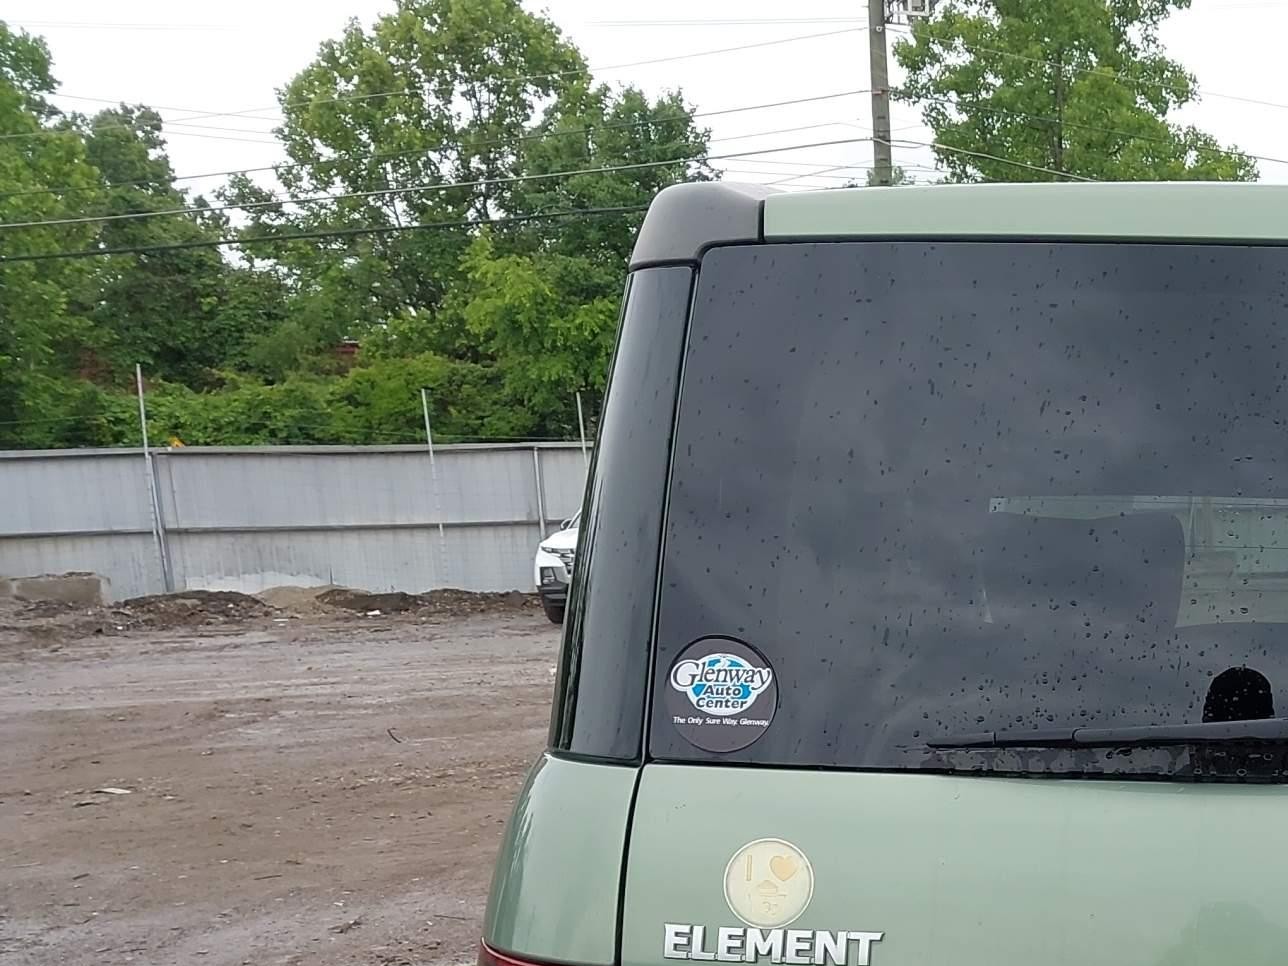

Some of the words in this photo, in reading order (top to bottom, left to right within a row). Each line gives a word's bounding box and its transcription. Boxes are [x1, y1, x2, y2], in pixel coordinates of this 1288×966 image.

[672, 661, 771, 691] Glenway
[702, 685, 742, 696] Auto
[695, 698, 748, 709] Center
[673, 716, 686, 724] The
[687, 717, 703, 726] Only
[705, 717, 721, 725] Sure
[663, 923, 885, 966] ELEMENT
